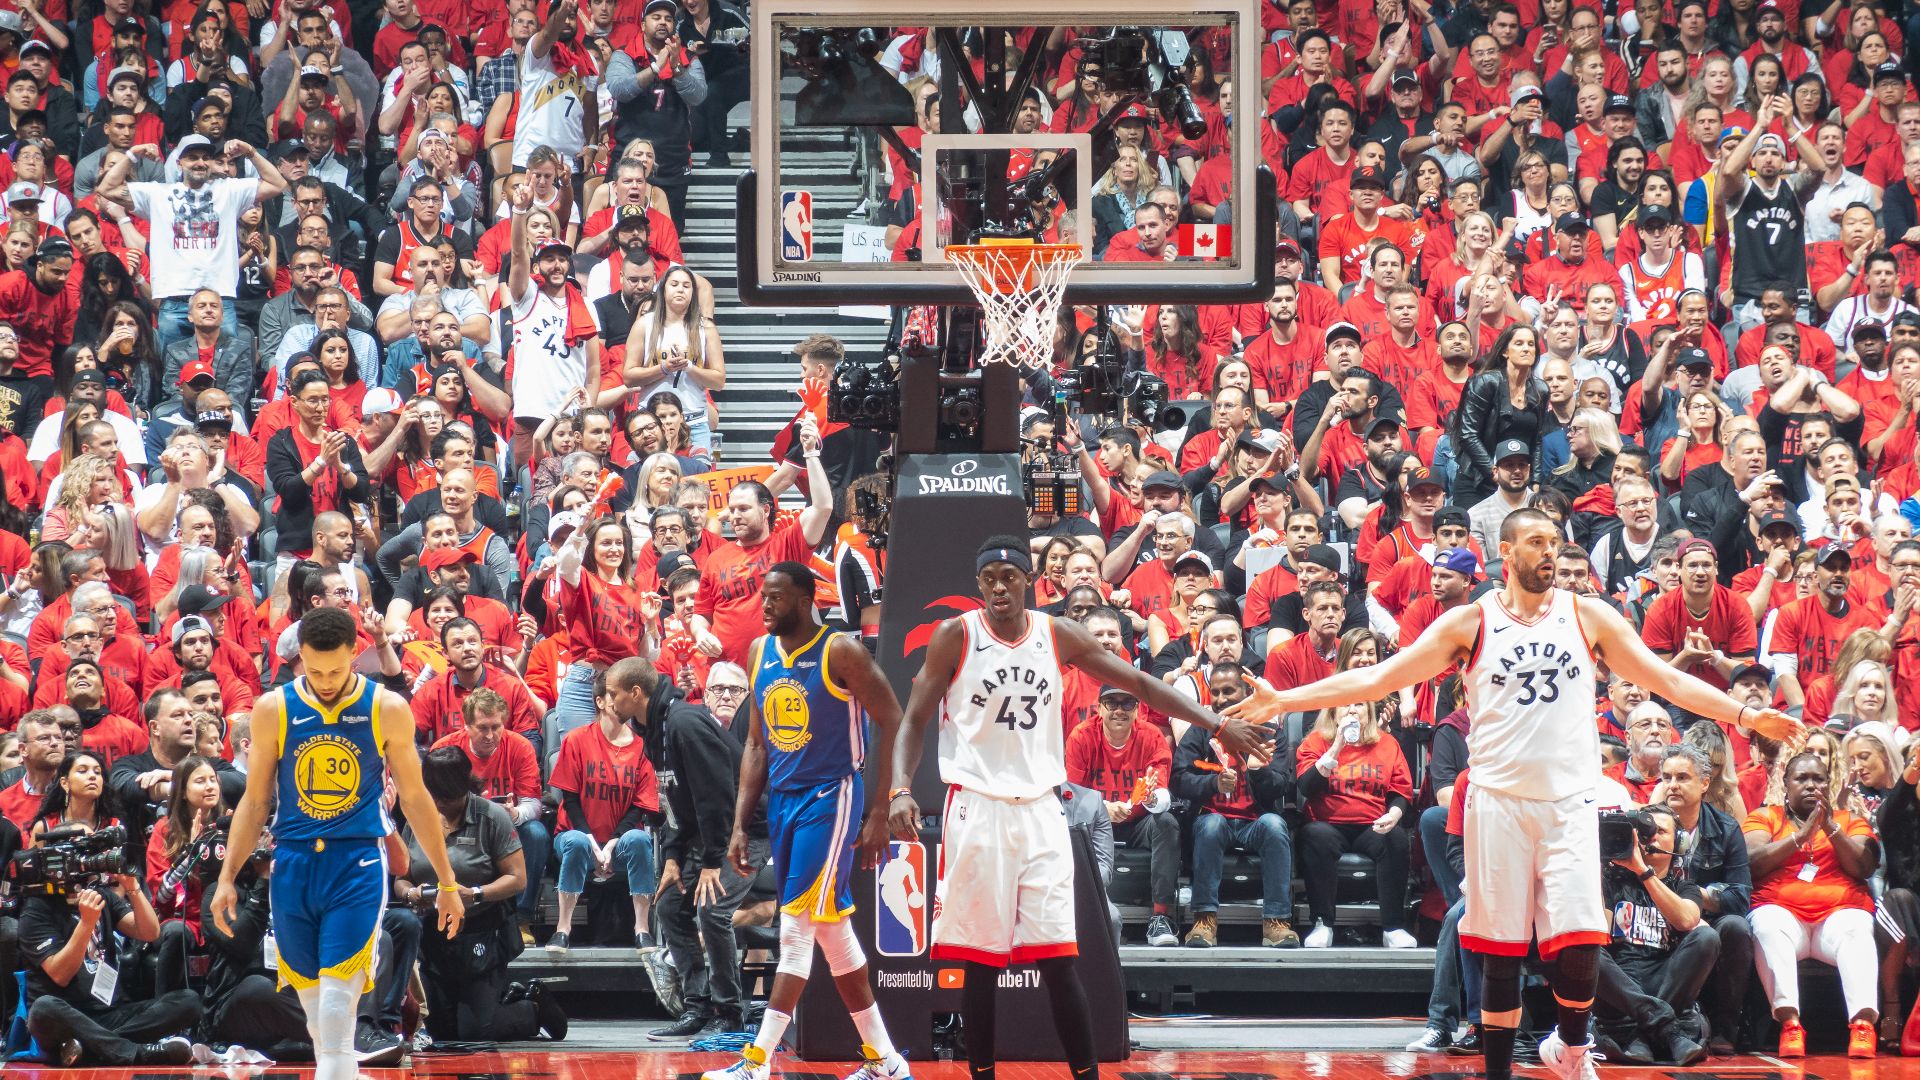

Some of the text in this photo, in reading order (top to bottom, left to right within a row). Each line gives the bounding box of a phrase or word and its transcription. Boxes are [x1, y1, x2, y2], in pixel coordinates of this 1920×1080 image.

[546, 76, 582, 95] NORT
[564, 95, 576, 118] 7
[653, 88, 665, 112] 7
[1746, 206, 1797, 230] RAPTORS
[173, 237, 217, 250] NORTH
[1766, 222, 1781, 245] 7
[785, 246, 801, 258] NBA
[243, 267, 261, 285] 12
[772, 272, 822, 284] SPALDING
[531, 315, 584, 349] RAPTS
[1362, 321, 1382, 335] WE
[653, 351, 698, 367] NOTH
[1266, 356, 1313, 382] WE THE
[1784, 427, 1802, 442] WE
[918, 474, 1008, 495] SPALDING
[718, 567, 739, 583] WE
[592, 591, 611, 612] WE
[1143, 595, 1162, 612] WE
[1803, 634, 1826, 657] WE
[1491, 642, 1581, 686] RAPTORS
[762, 677, 809, 698] GOLDEN STATE
[970, 666, 1052, 709] RAPTORS
[1516, 668, 1559, 706] 33
[785, 697, 801, 713] 23
[994, 695, 1039, 731] 43
[293, 735, 362, 757] GOLDEN STATE
[767, 731, 813, 753] WARRIORS
[325, 757, 351, 775] 30
[586, 760, 608, 780] WE
[1347, 763, 1384, 779] THE
[1330, 777, 1386, 796] ORTH
[296, 794, 361, 821] WARRIORS
[1633, 905, 1658, 926] NBA
[877, 969, 934, 991] Presented by
[998, 970, 1041, 989] ubeTV
